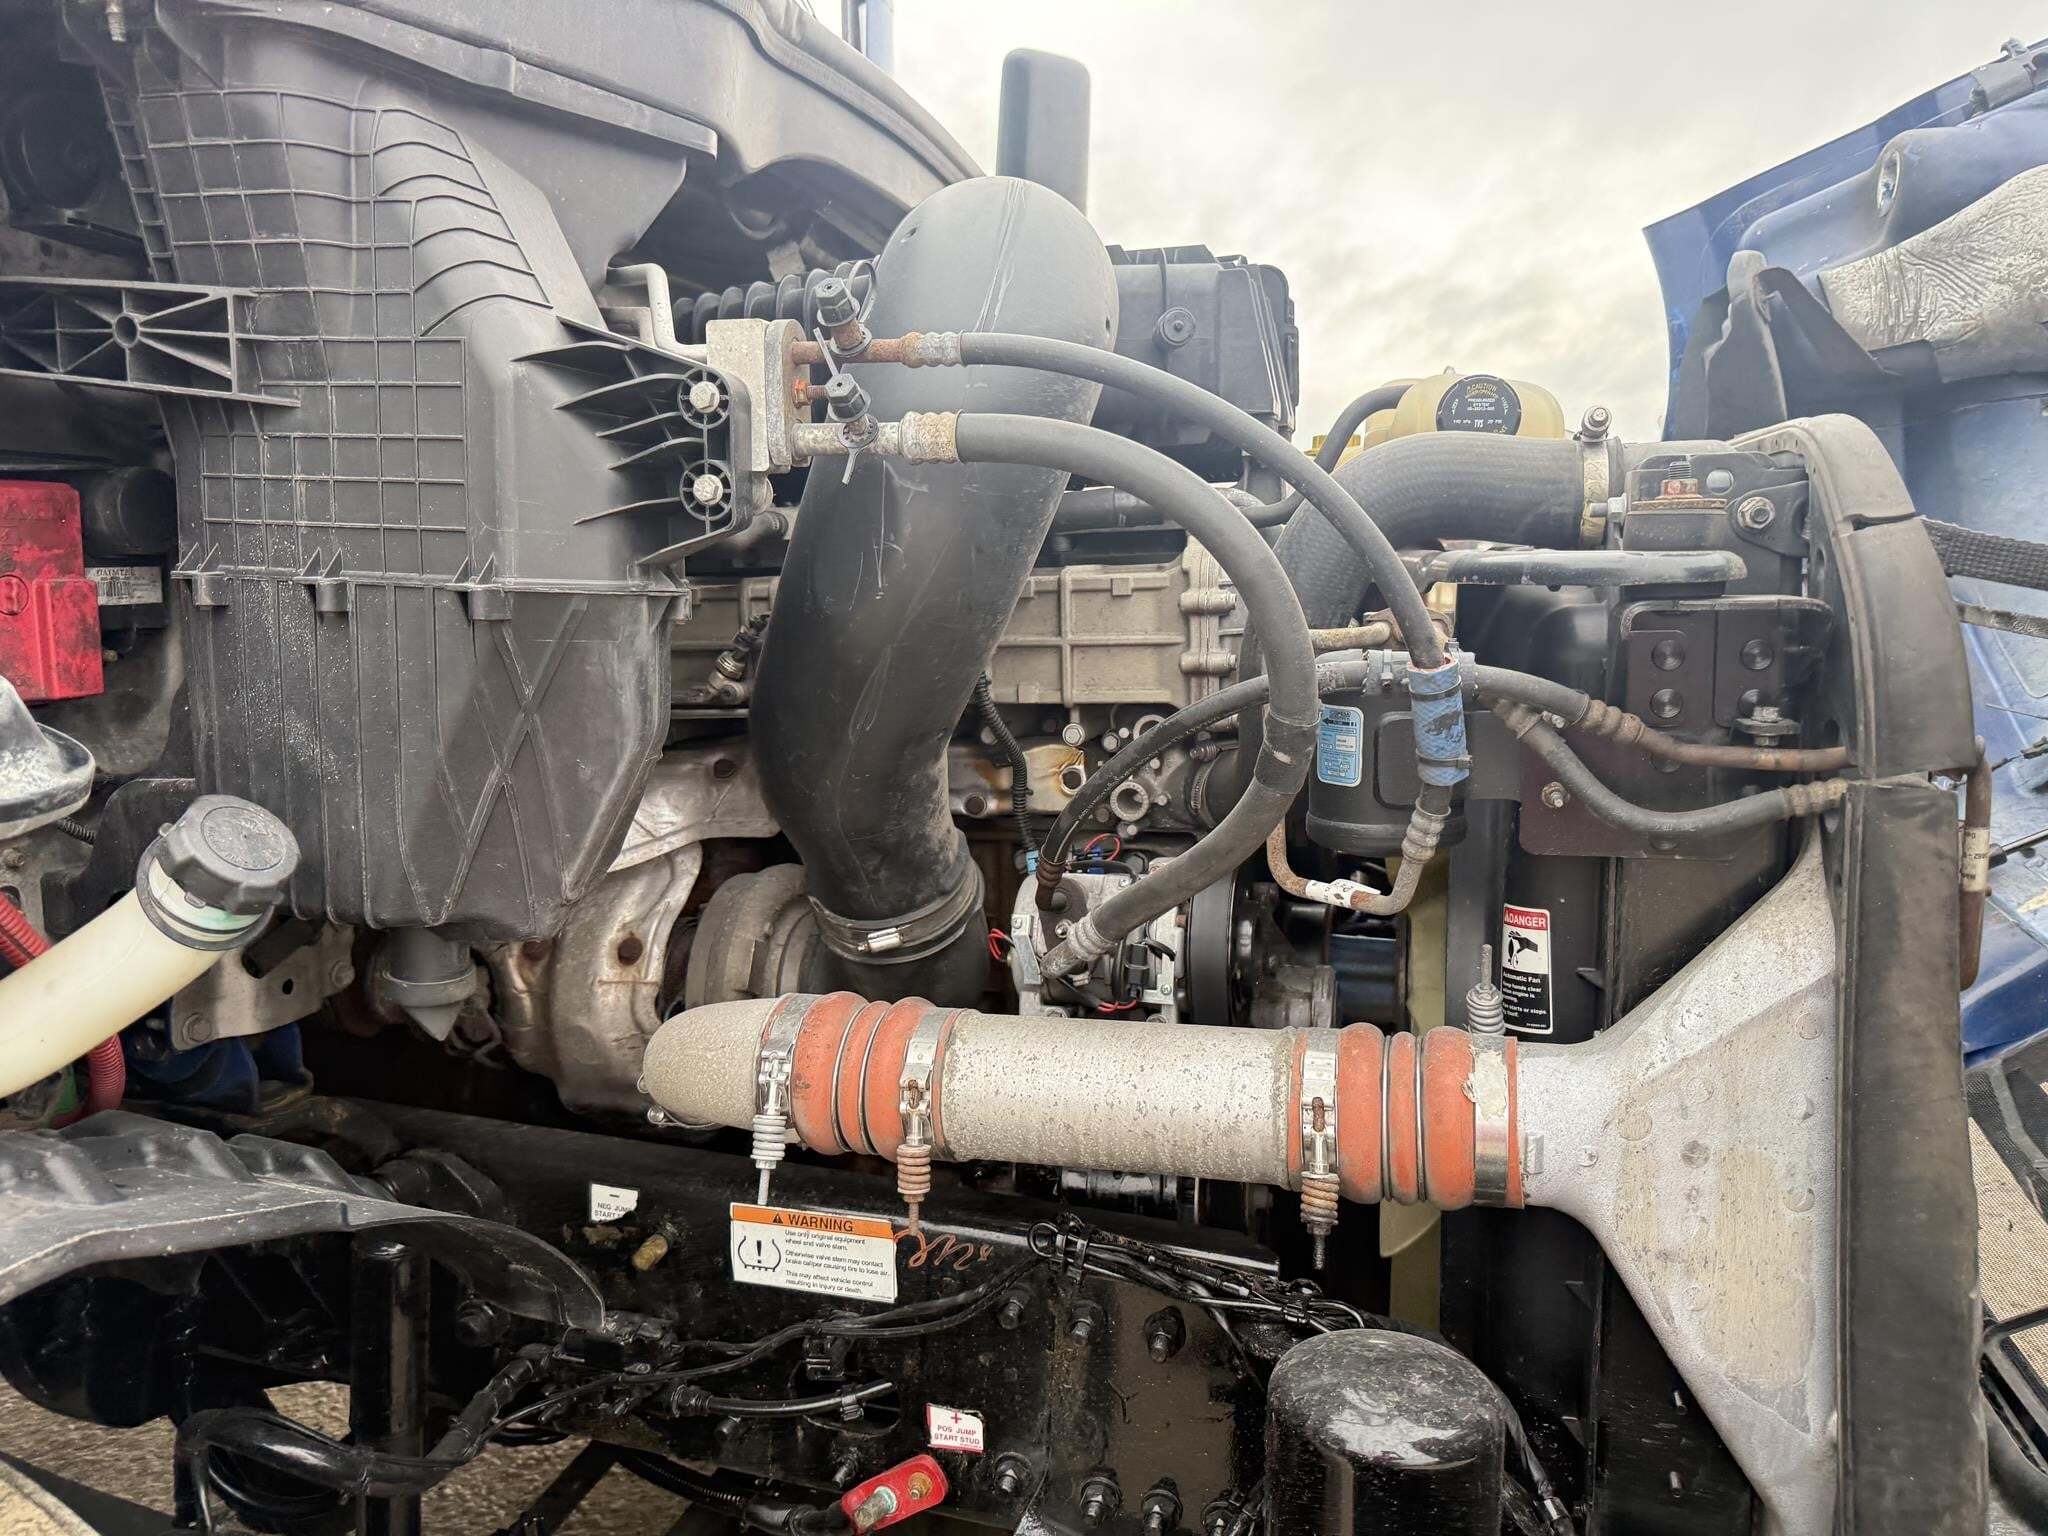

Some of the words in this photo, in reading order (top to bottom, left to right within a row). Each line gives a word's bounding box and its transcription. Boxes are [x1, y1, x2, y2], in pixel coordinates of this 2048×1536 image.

[1509, 912, 1547, 928] DANGER
[597, 1202, 611, 1210] NEG
[594, 1209, 616, 1218] START
[788, 1213, 854, 1232] WARNING
[785, 1229, 796, 1237] Use
[797, 1231, 810, 1239] only
[811, 1233, 833, 1241] original
[834, 1235, 865, 1245] equipment
[785, 1249, 815, 1258] Otherwise
[847, 1258, 860, 1266] may
[861, 1260, 883, 1268] contact
[803, 1260, 822, 1269] caliper
[823, 1263, 847, 1272] causing
[785, 1269, 798, 1277] This
[799, 1272, 811, 1280] may
[830, 1276, 851, 1284] vehicle
[852, 1279, 873, 1287] control
[785, 1279, 811, 1288] resulting
[819, 1283, 836, 1291] injury
[937, 1424, 953, 1433] POS
[956, 1427, 976, 1436] JUMP
[934, 1432, 959, 1442] START
[959, 1436, 980, 1446] STUD
